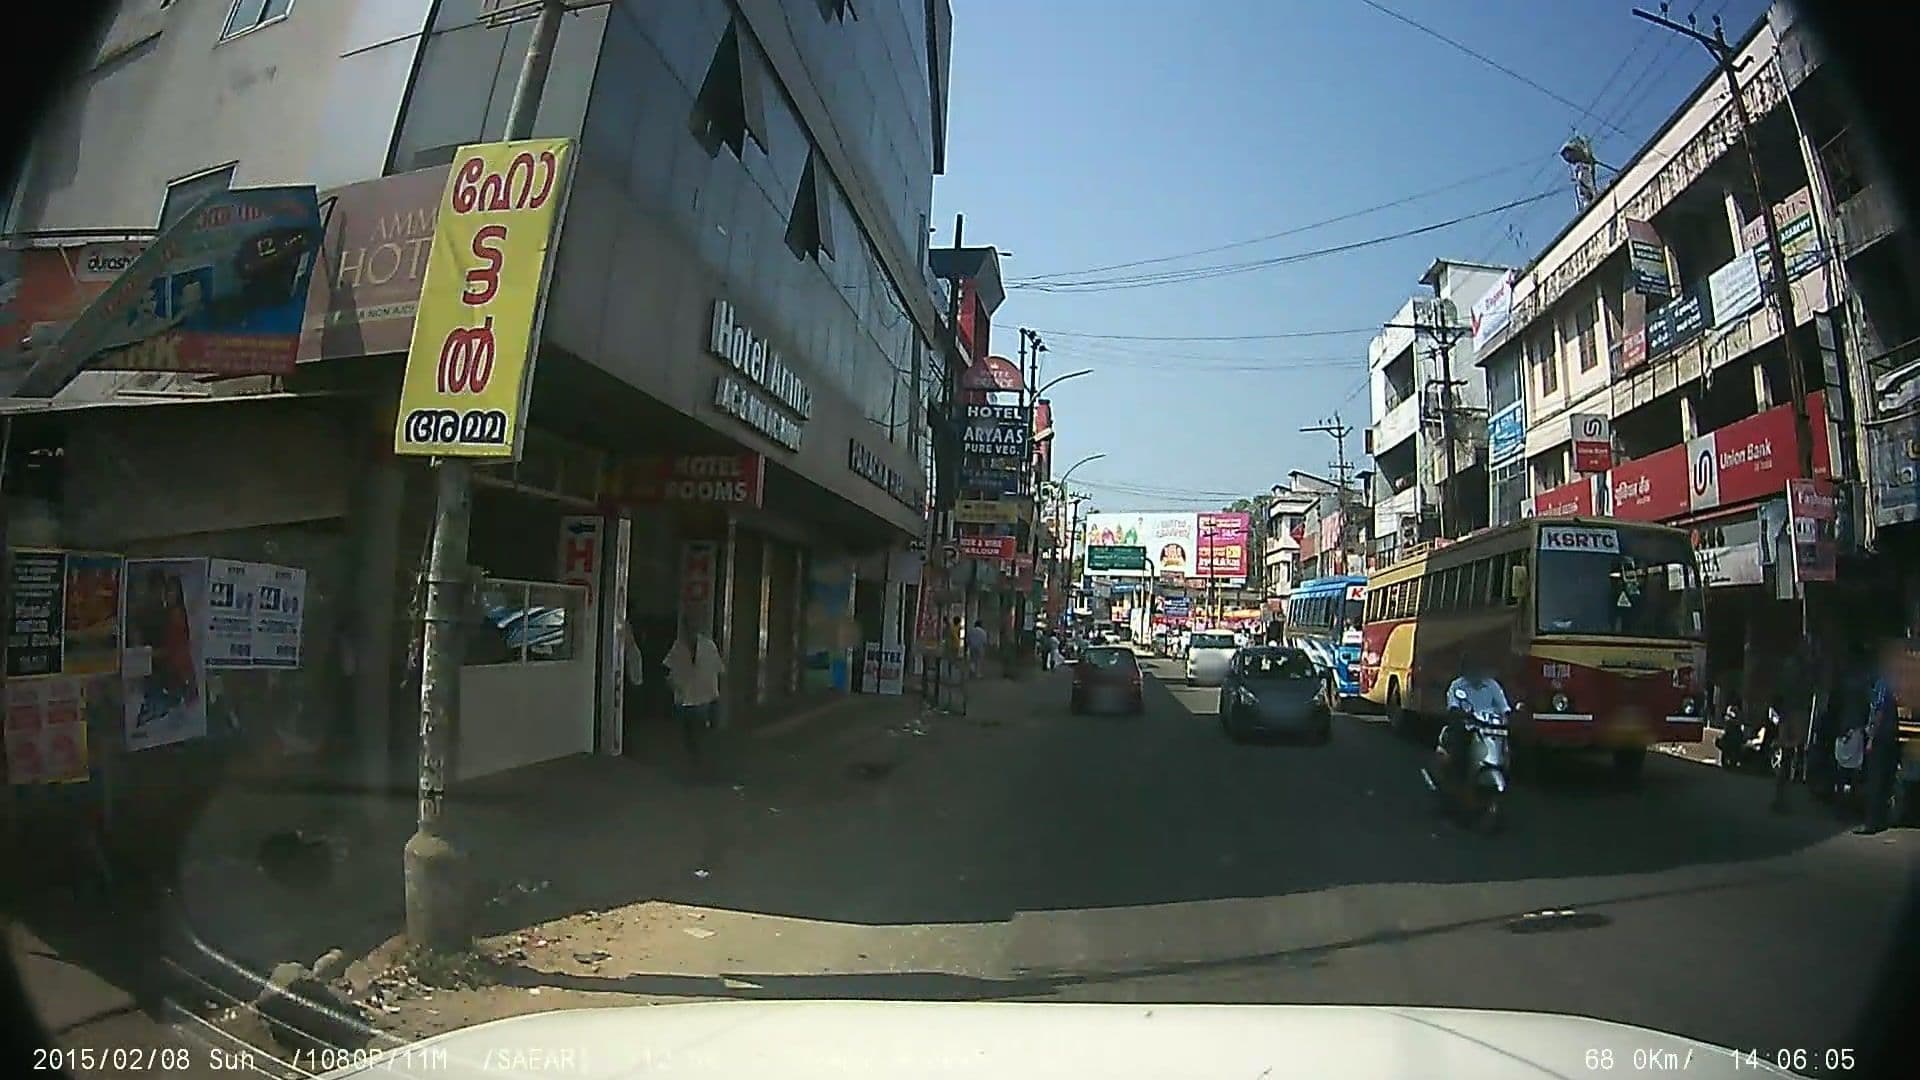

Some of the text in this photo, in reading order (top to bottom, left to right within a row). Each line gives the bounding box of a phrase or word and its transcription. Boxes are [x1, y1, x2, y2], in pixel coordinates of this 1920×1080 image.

[711, 300, 768, 385] Hotel
[967, 406, 1022, 419] HOTEL
[404, 409, 509, 445] അമ്മ
[963, 426, 1024, 444] ARYAAS
[965, 443, 992, 454] PURE
[1720, 438, 1772, 470] Union Bank
[1547, 532, 1615, 549] KSRTC
